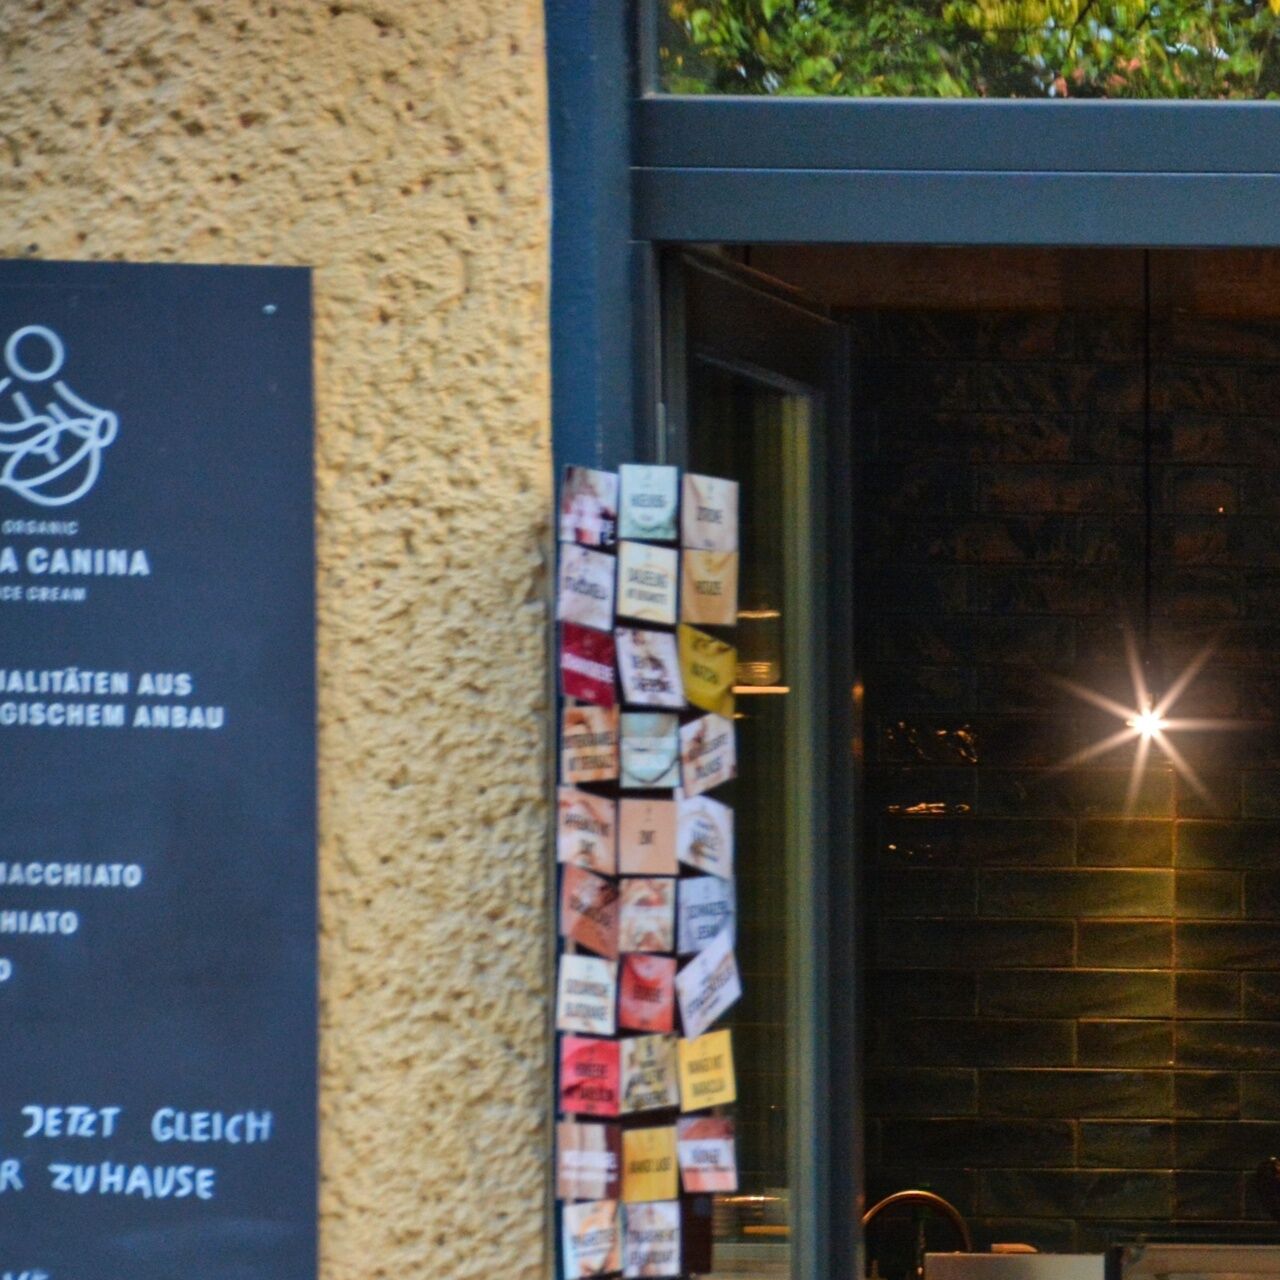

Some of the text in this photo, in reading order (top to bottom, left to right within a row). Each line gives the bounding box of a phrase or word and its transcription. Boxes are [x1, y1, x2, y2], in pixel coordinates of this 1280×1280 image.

[2, 520, 78, 535] ORGANIC
[27, 548, 150, 575] CANINA
[0, 586, 86, 601] CE CREAM
[137, 672, 192, 696] AUS
[132, 705, 224, 729] ANBAU
[21, 1105, 272, 1143] JETZT GLEICH
[48, 1161, 216, 1199] ZUHAUSE
